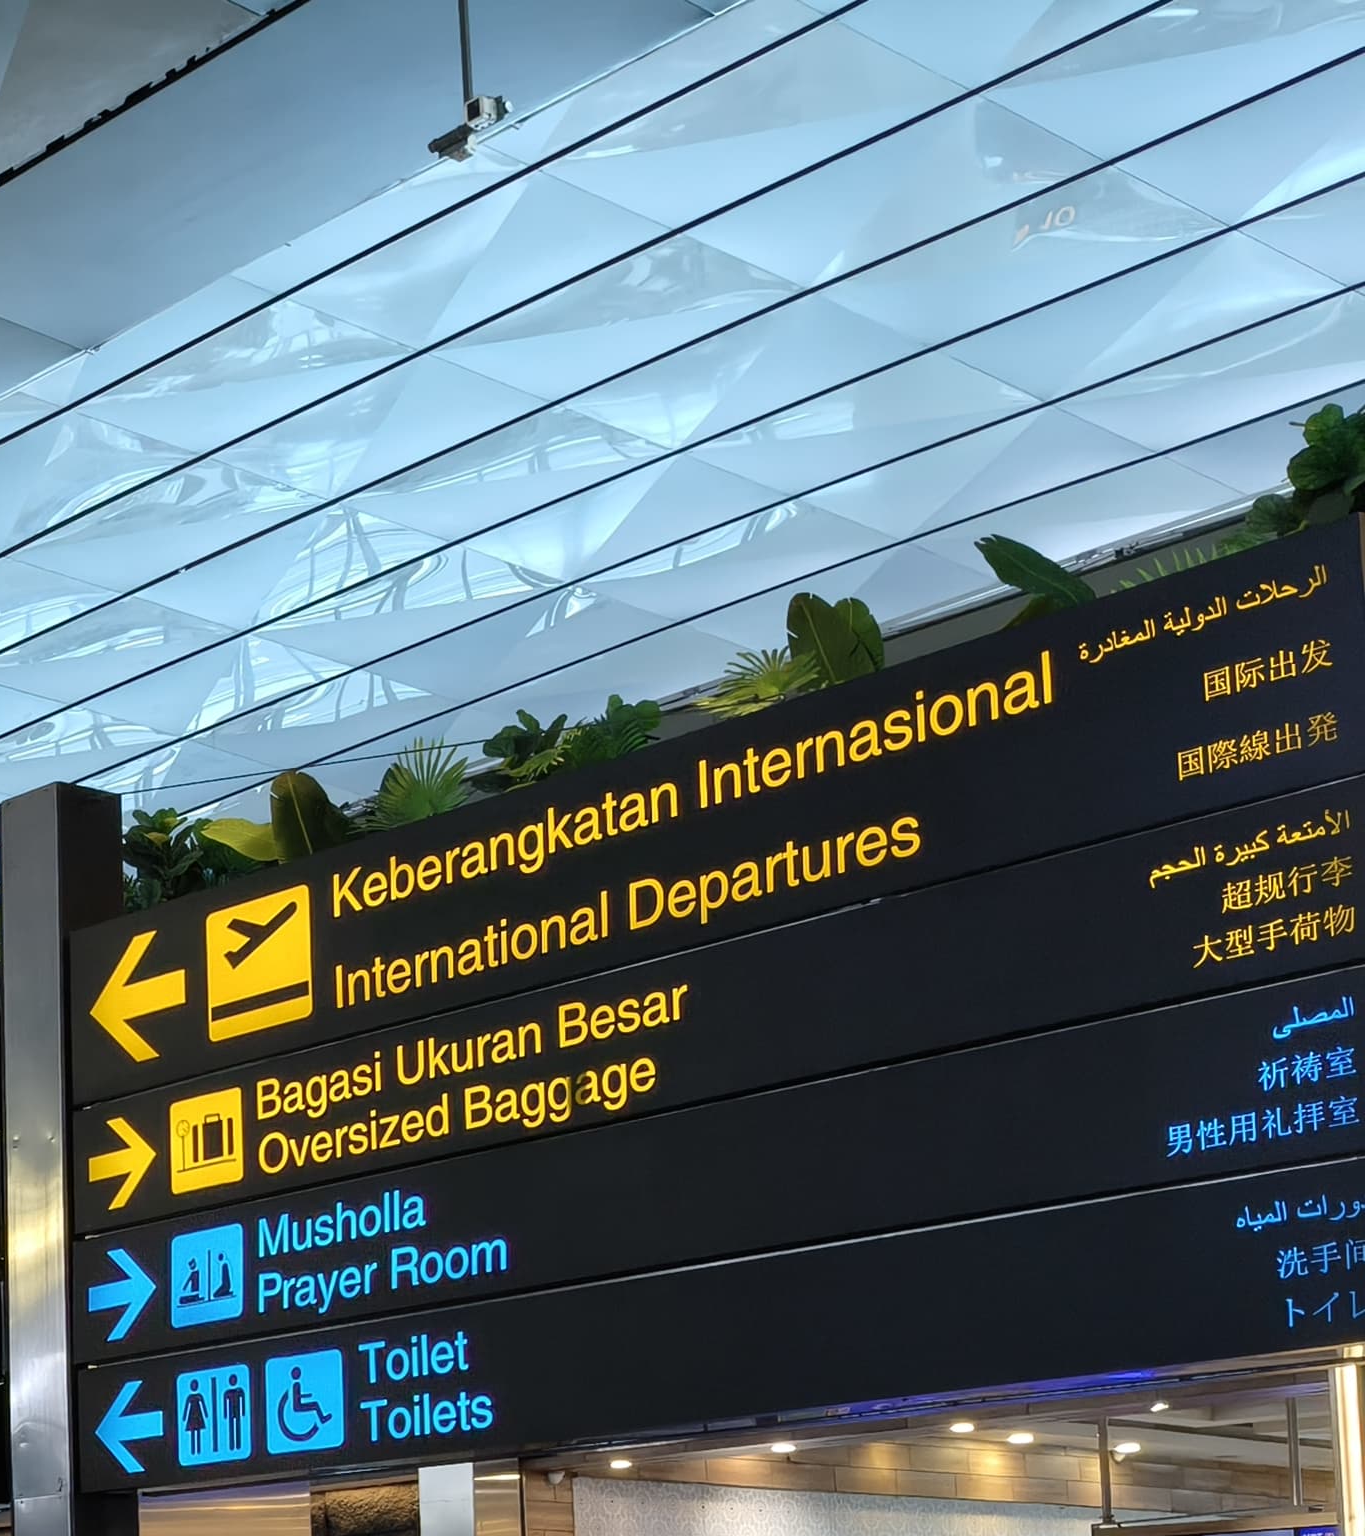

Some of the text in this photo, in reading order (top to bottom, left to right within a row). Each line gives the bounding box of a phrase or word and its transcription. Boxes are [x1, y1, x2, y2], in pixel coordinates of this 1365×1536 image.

[1078, 564, 1327, 661] الرحلات الدولية المغادرة
[1203, 639, 1333, 702] 国际出发
[1177, 712, 1338, 781] 国際線出発
[332, 651, 1054, 918] Keberangkatan Internasional
[1148, 809, 1350, 888] الأمتعة كبيرة الحجم
[335, 816, 921, 1009] International Departures
[1220, 856, 1353, 913] 超规行李
[1192, 905, 1356, 968] 大型手荷物
[1272, 996, 1356, 1040] المصلى
[256, 983, 689, 1121] Bagasi Ukuran Besar
[1257, 1045, 1357, 1092] 祈祷室
[257, 1057, 657, 1174] Oversized Baggage
[1166, 1095, 1360, 1158] 男性用礼拝室
[258, 1189, 427, 1259] Musholla
[1235, 1194, 1365, 1232] ورات المياه
[257, 1238, 508, 1314] Prayer Room
[357, 1330, 470, 1384] Toilet
[359, 1391, 494, 1443] Toilets
